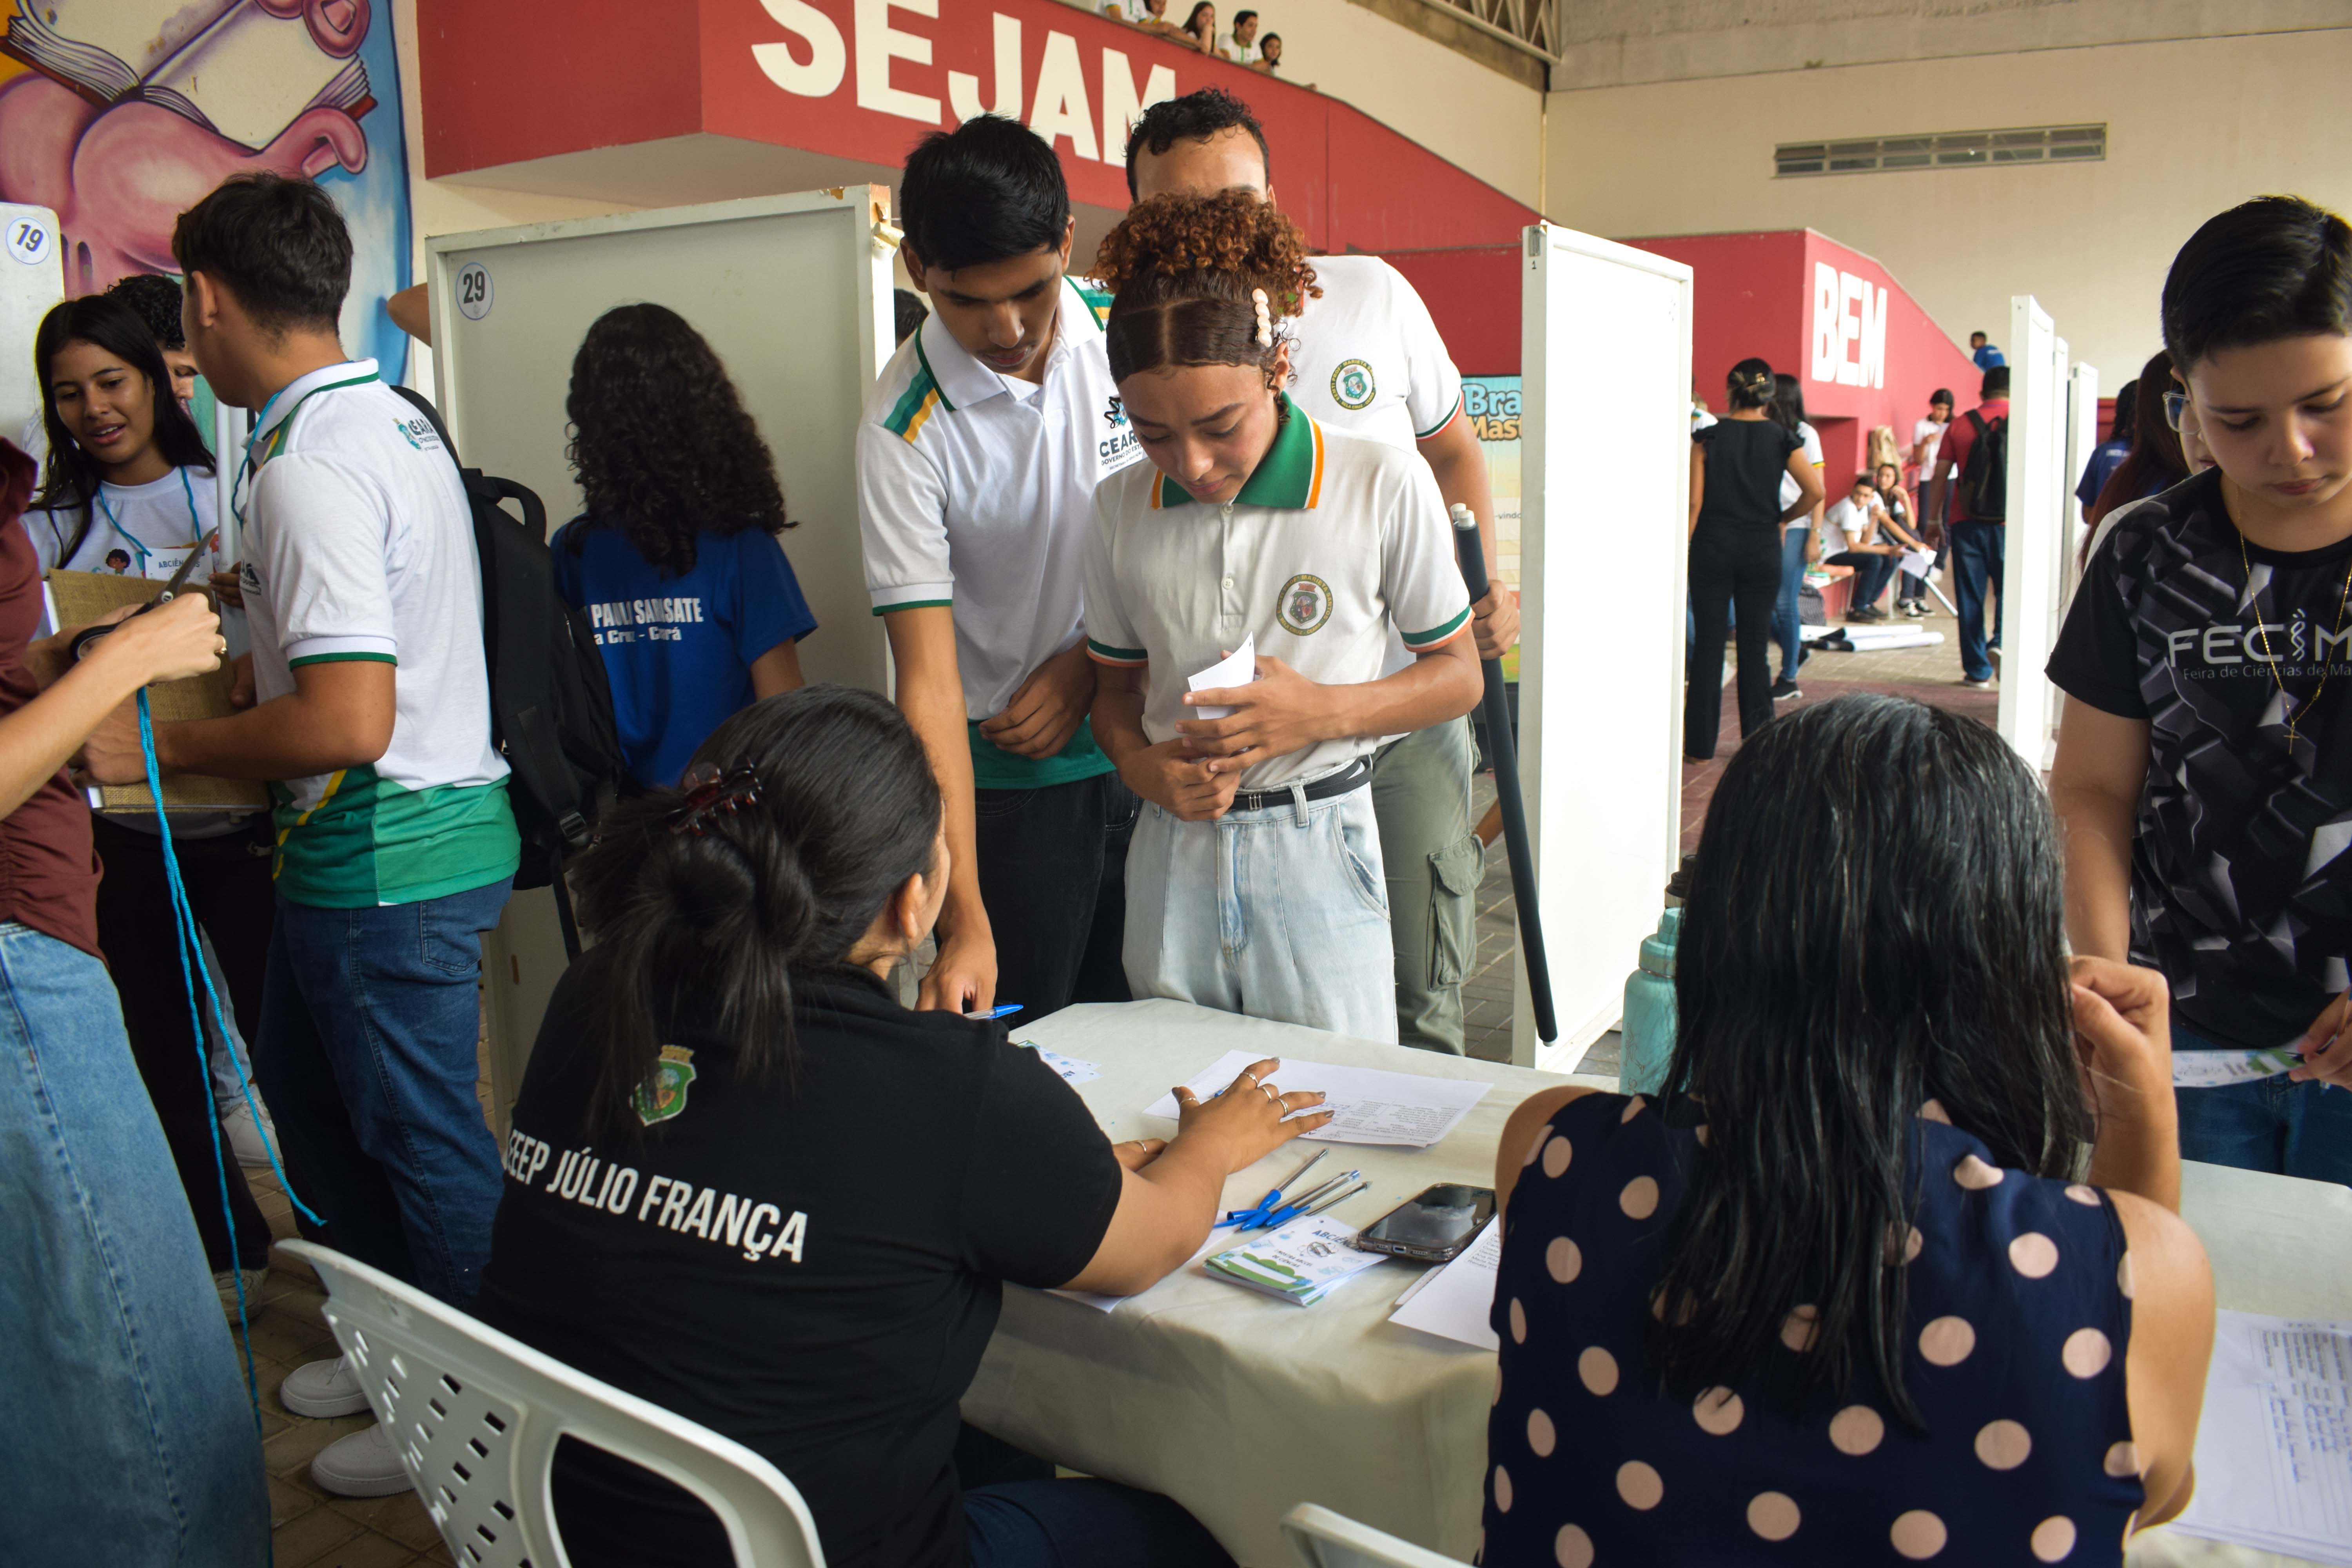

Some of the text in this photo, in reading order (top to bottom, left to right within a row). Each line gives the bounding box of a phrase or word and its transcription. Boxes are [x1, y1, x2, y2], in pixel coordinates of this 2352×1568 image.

[751, 0, 1176, 168] SEJAM
[17, 224, 44, 252] 19
[463, 271, 485, 304] 29
[1811, 261, 1887, 389] BEM
[1461, 383, 1522, 417] Bra
[1101, 452, 1125, 466] GOVERNO
[1323, 592, 1332, 619] SANTOS
[2184, 668, 2215, 680] Feira
[2220, 665, 2238, 677] de
[2243, 664, 2302, 677] Ciências
[2307, 665, 2324, 676] de
[546, 1146, 639, 1215] JÚLIO
[638, 1175, 808, 1263] FRANÇA
